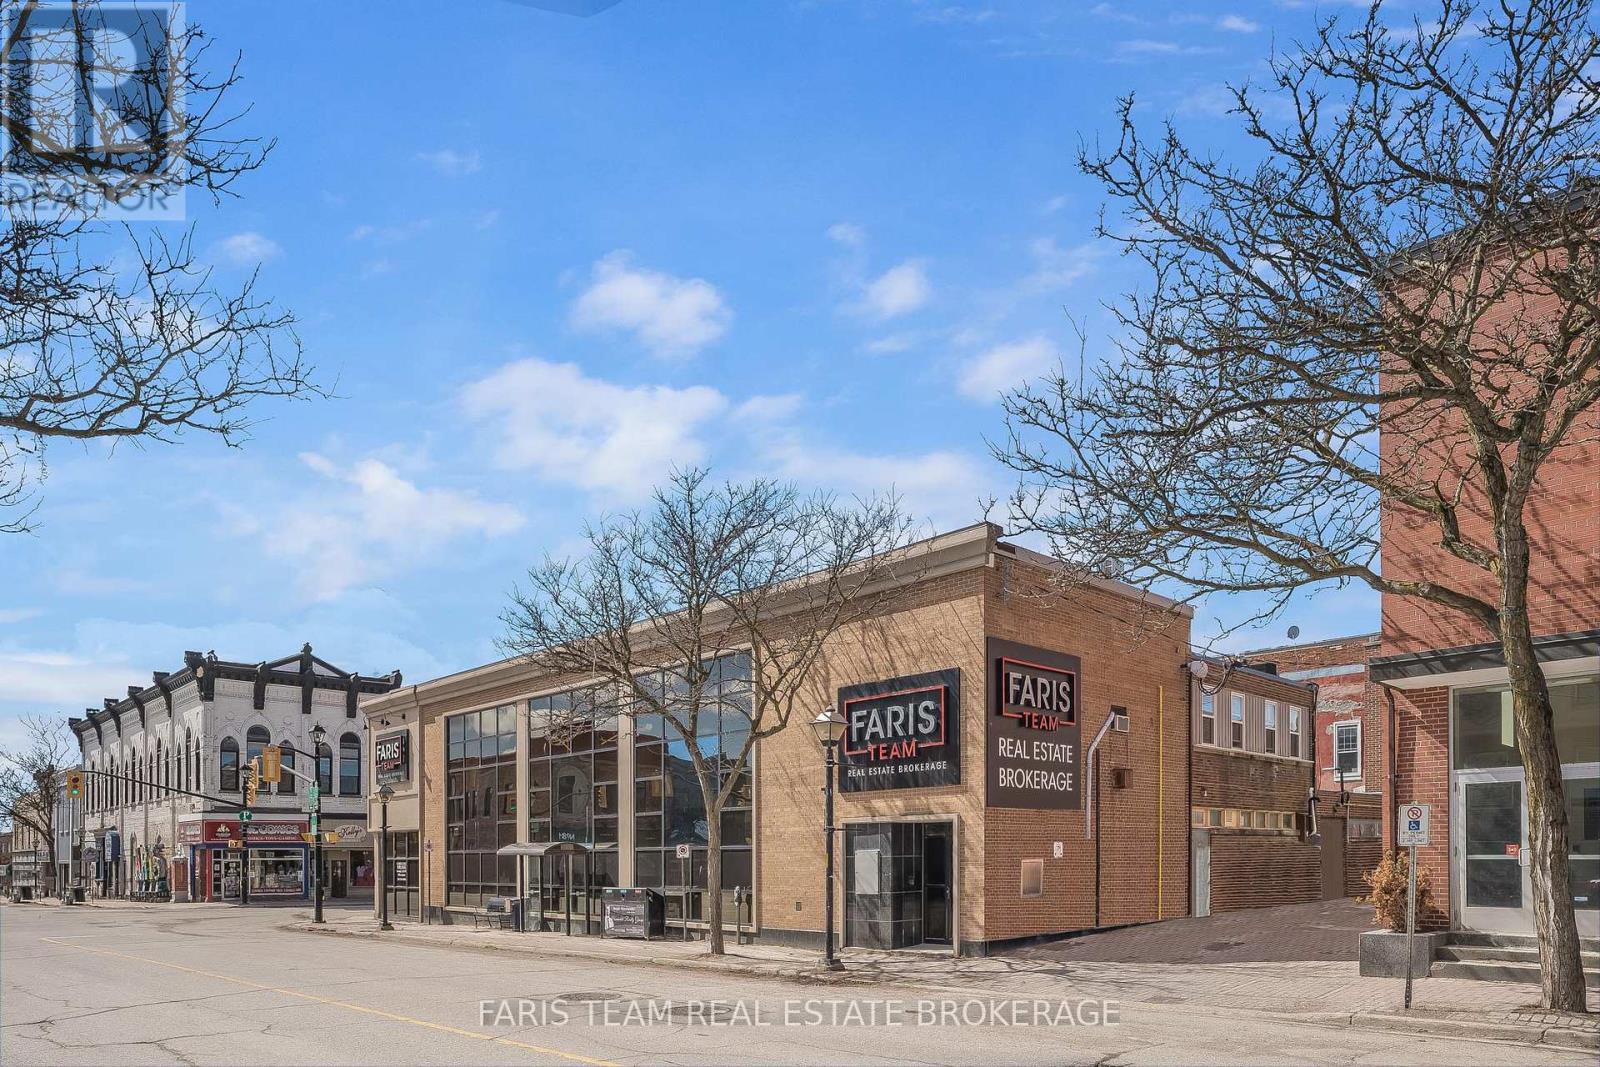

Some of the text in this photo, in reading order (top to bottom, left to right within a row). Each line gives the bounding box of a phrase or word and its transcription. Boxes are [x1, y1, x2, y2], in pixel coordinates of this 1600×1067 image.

[1009, 672, 1071, 713] FARIS
[852, 700, 936, 742] FARIS
[1023, 711, 1059, 732] TEAM
[377, 742, 399, 761] FARIS
[868, 738, 917, 761] TEAM
[999, 737, 1073, 764] REAL ESTATE
[848, 761, 947, 778] REAL ESTATE BROKERAGE
[999, 767, 1073, 791] BROKERAGE
